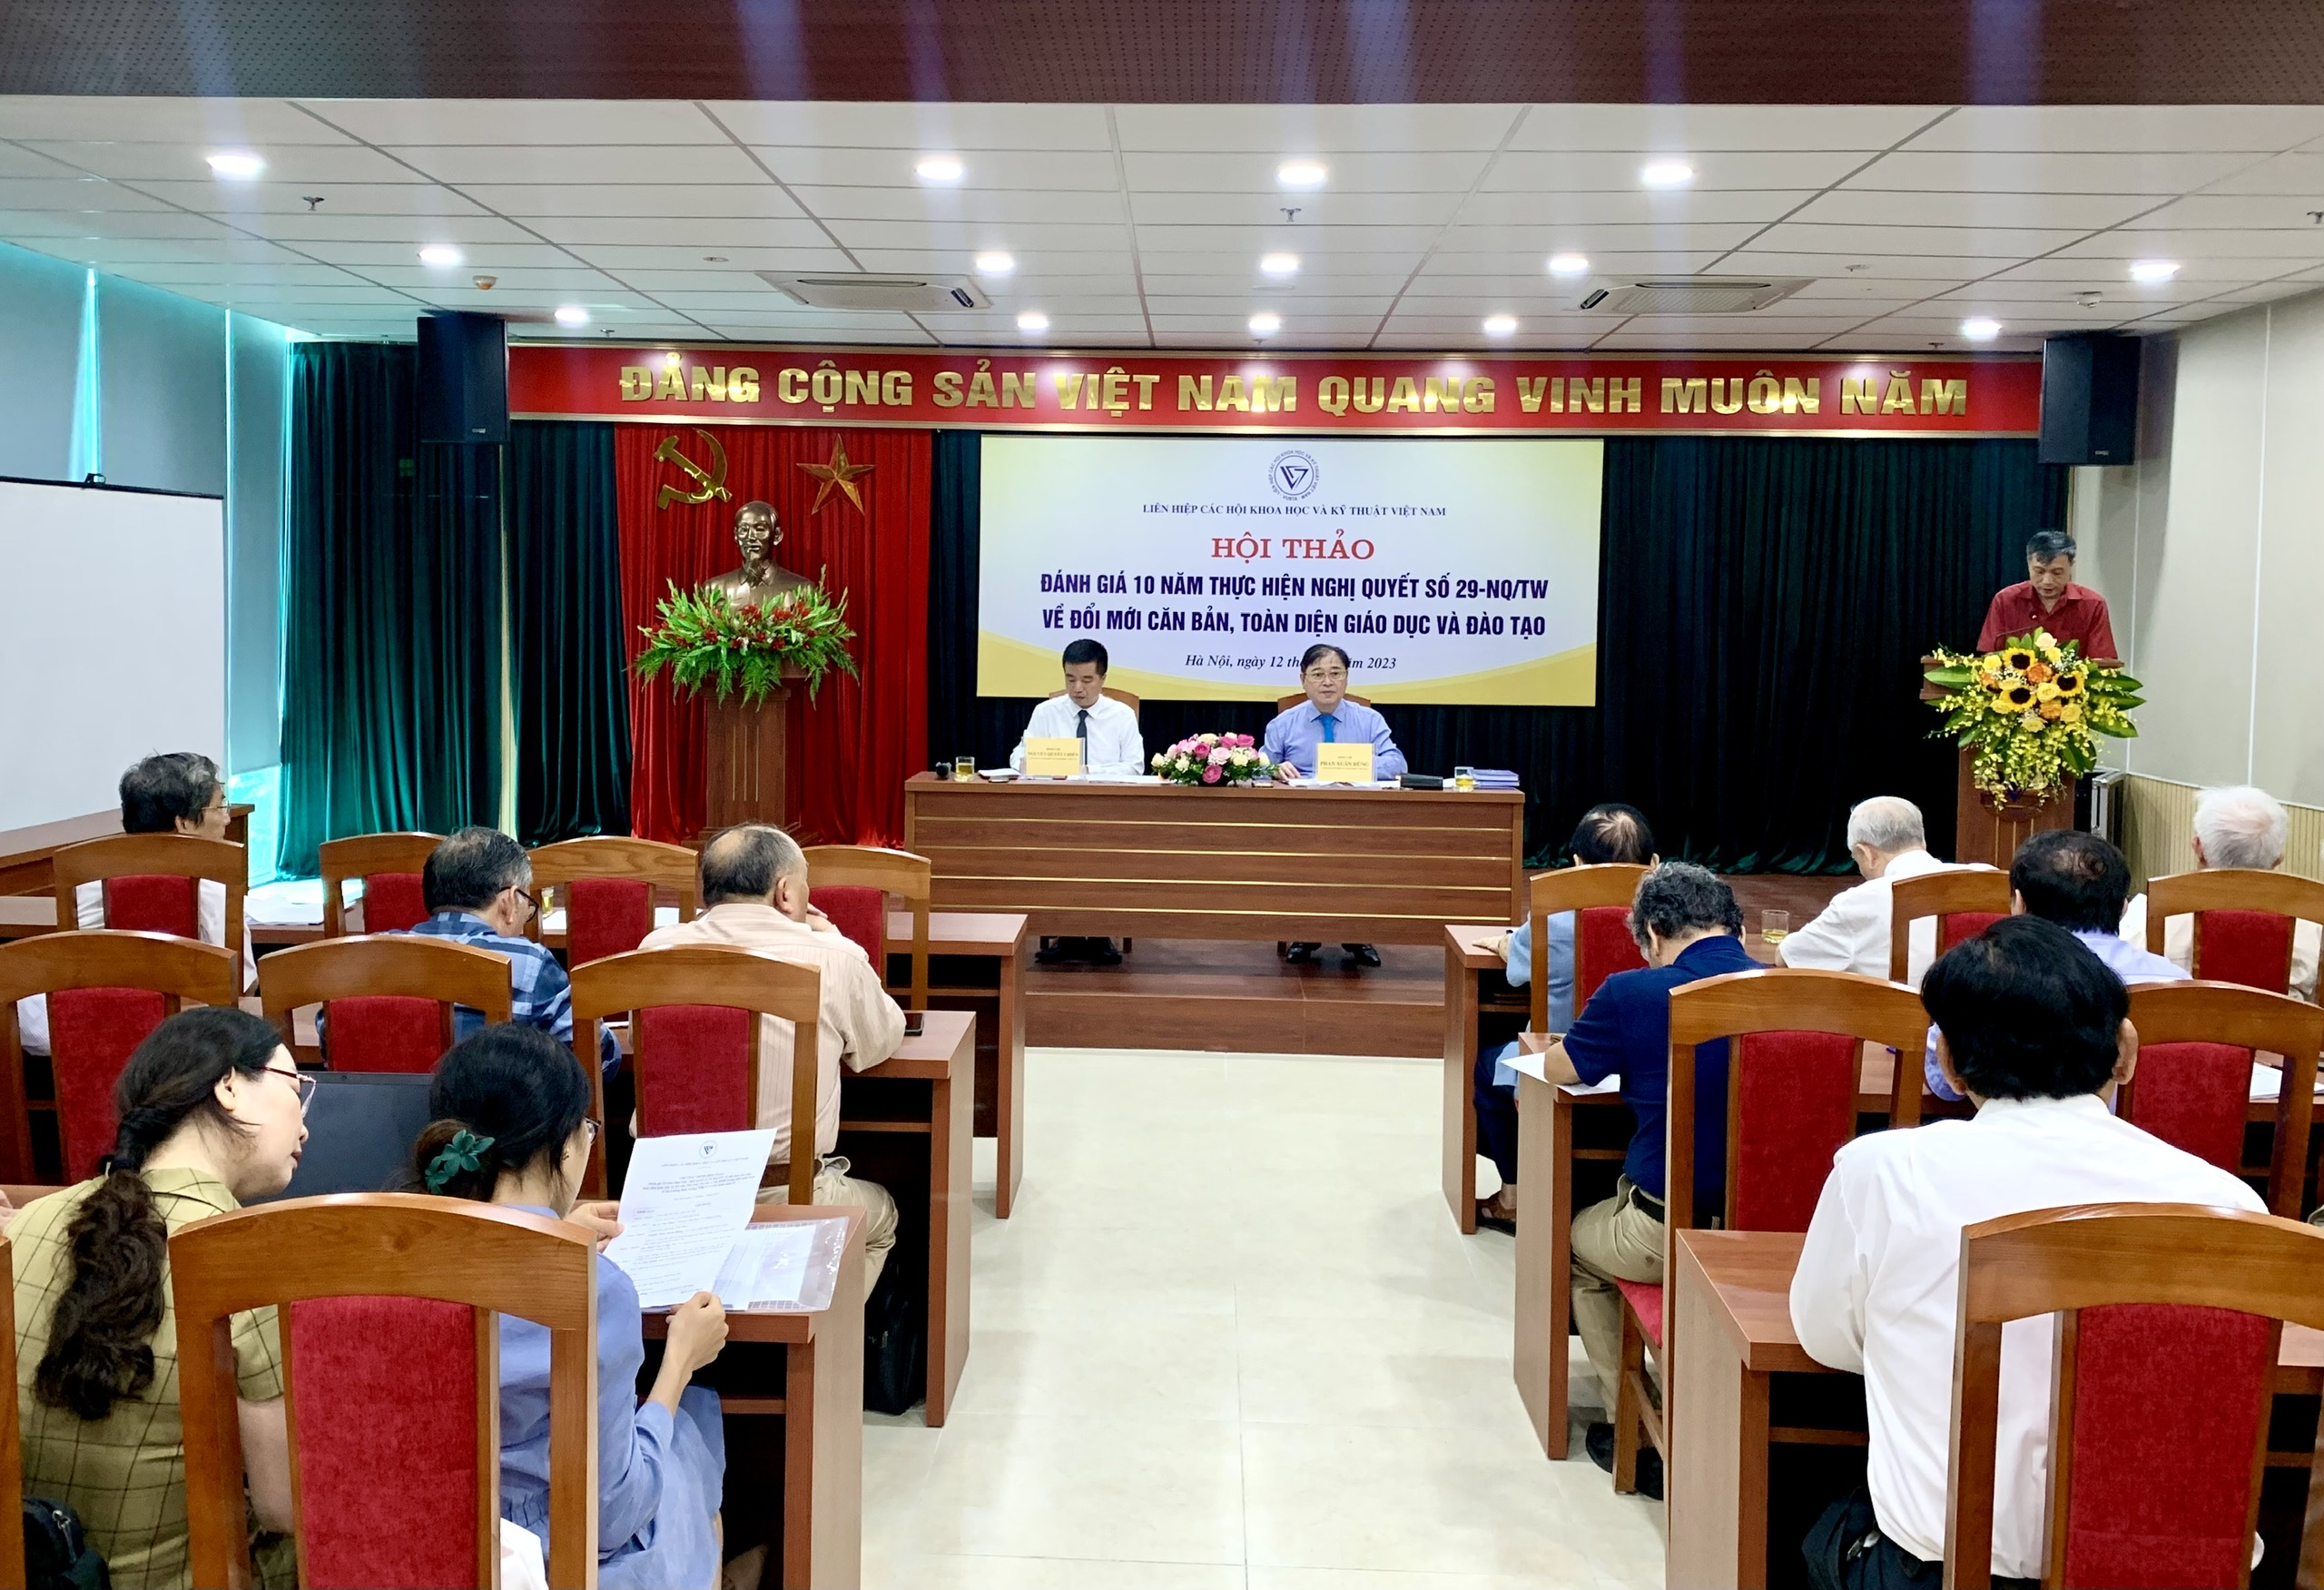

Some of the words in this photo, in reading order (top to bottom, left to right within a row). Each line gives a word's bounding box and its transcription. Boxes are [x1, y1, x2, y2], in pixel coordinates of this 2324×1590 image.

[619, 352, 761, 403] ĐẢNG
[778, 360, 912, 412] CỘNG
[933, 359, 1036, 408] SẢN
[1057, 366, 1159, 418] VIỆT
[1177, 374, 1297, 413] NAM
[1317, 374, 1496, 417] QUANG
[1517, 376, 1642, 414] VINH
[1660, 370, 1821, 415] MUÔN
[1840, 370, 1968, 416] NĂM
[1144, 502, 1168, 513] LIÊN
[1172, 503, 1197, 515] HIỆP
[1200, 503, 1223, 514] CÁC
[1226, 503, 1246, 516] HỘI
[1250, 506, 1282, 514] KHOA
[1285, 507, 1309, 517] HỌC
[1313, 504, 1327, 515] VÀ
[1331, 505, 1346, 515] KỸ
[1349, 505, 1388, 517] THUẬT
[1392, 505, 1417, 518] VIỆT
[1421, 508, 1445, 516] NAM
[1211, 531, 1271, 564] HỘI
[1283, 528, 1374, 559] THẢO
[1040, 569, 1090, 593] ĐÁNH
[1098, 570, 1127, 594] GIÁ
[1134, 576, 1155, 594] 10
[1161, 572, 1203, 595] NĂM
[1209, 575, 1256, 599] THỰC
[1262, 573, 1305, 600] HIỆN
[1311, 578, 1355, 601] NGHỊ
[1362, 572, 1419, 599] QUYẾT
[1425, 572, 1450, 598] SỐ
[1455, 579, 1549, 601] 29-NQ/TW
[1042, 603, 1064, 628] VỀ
[1069, 602, 1100, 629] ĐỔI
[1107, 607, 1141, 630] MỚI
[1147, 607, 1185, 630] CĂN
[1191, 606, 1234, 634] BẢN,
[1241, 608, 1288, 632] TOÀN
[1295, 609, 1337, 637] DIỆN
[1344, 610, 1387, 634] GIÁO
[1393, 615, 1430, 638] DỤC
[1437, 611, 1460, 635] VÀ
[1466, 611, 1503, 635] ĐÀO
[1510, 617, 1545, 639] TẠO
[1186, 655, 1203, 666] Hà
[1207, 656, 1233, 668] Nội,
[1237, 656, 1265, 669] ngày
[1270, 657, 1283, 667] 12
[1366, 657, 1397, 669] 2023
